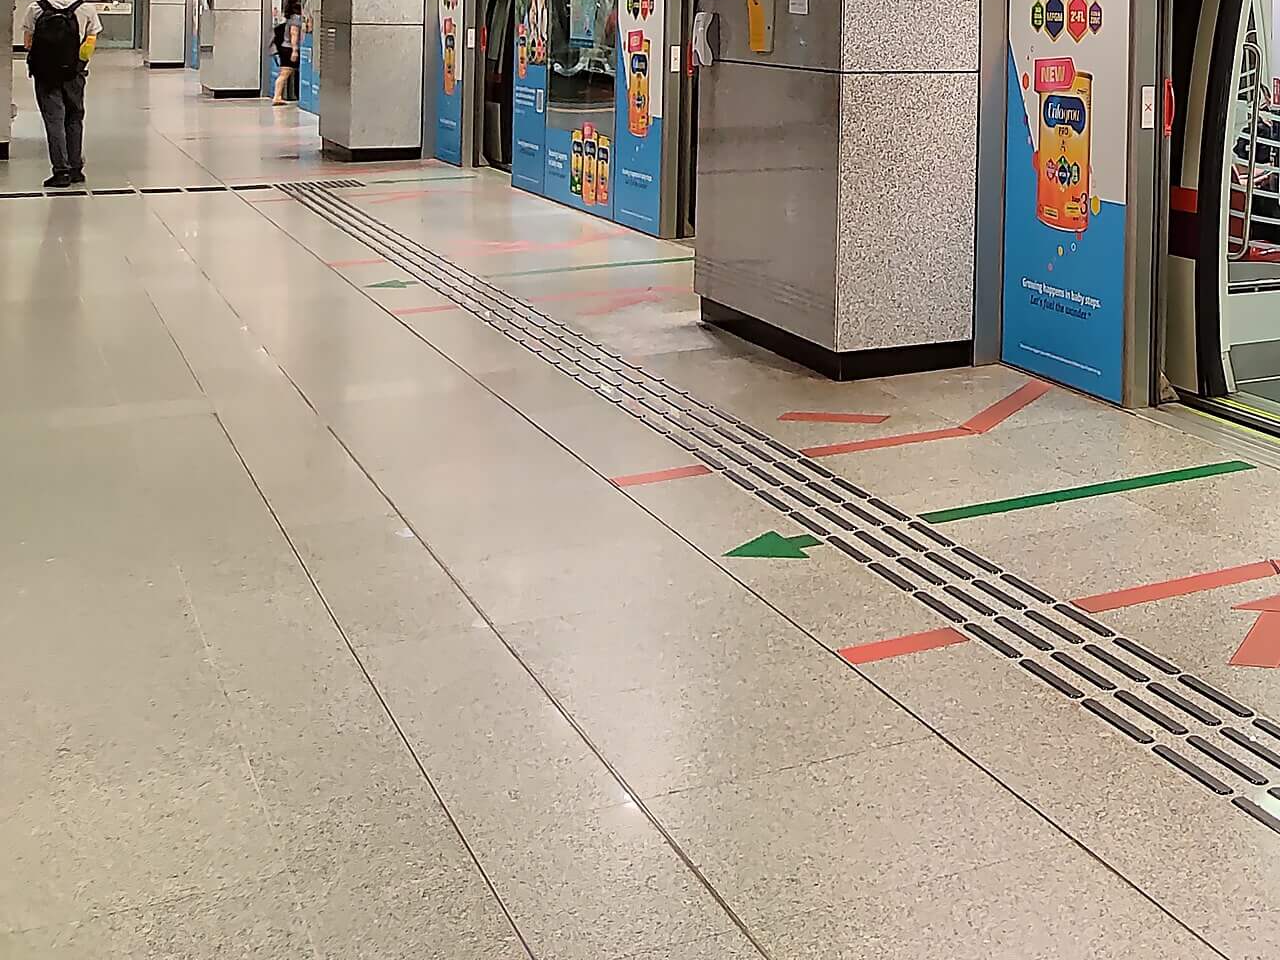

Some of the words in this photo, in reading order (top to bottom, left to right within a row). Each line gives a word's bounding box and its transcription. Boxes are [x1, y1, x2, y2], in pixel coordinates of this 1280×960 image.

[1040, 66, 1066, 82] NEW
[1080, 192, 1088, 216] 3
[1022, 277, 1042, 294] Growing
[1070, 290, 1085, 306] baby
